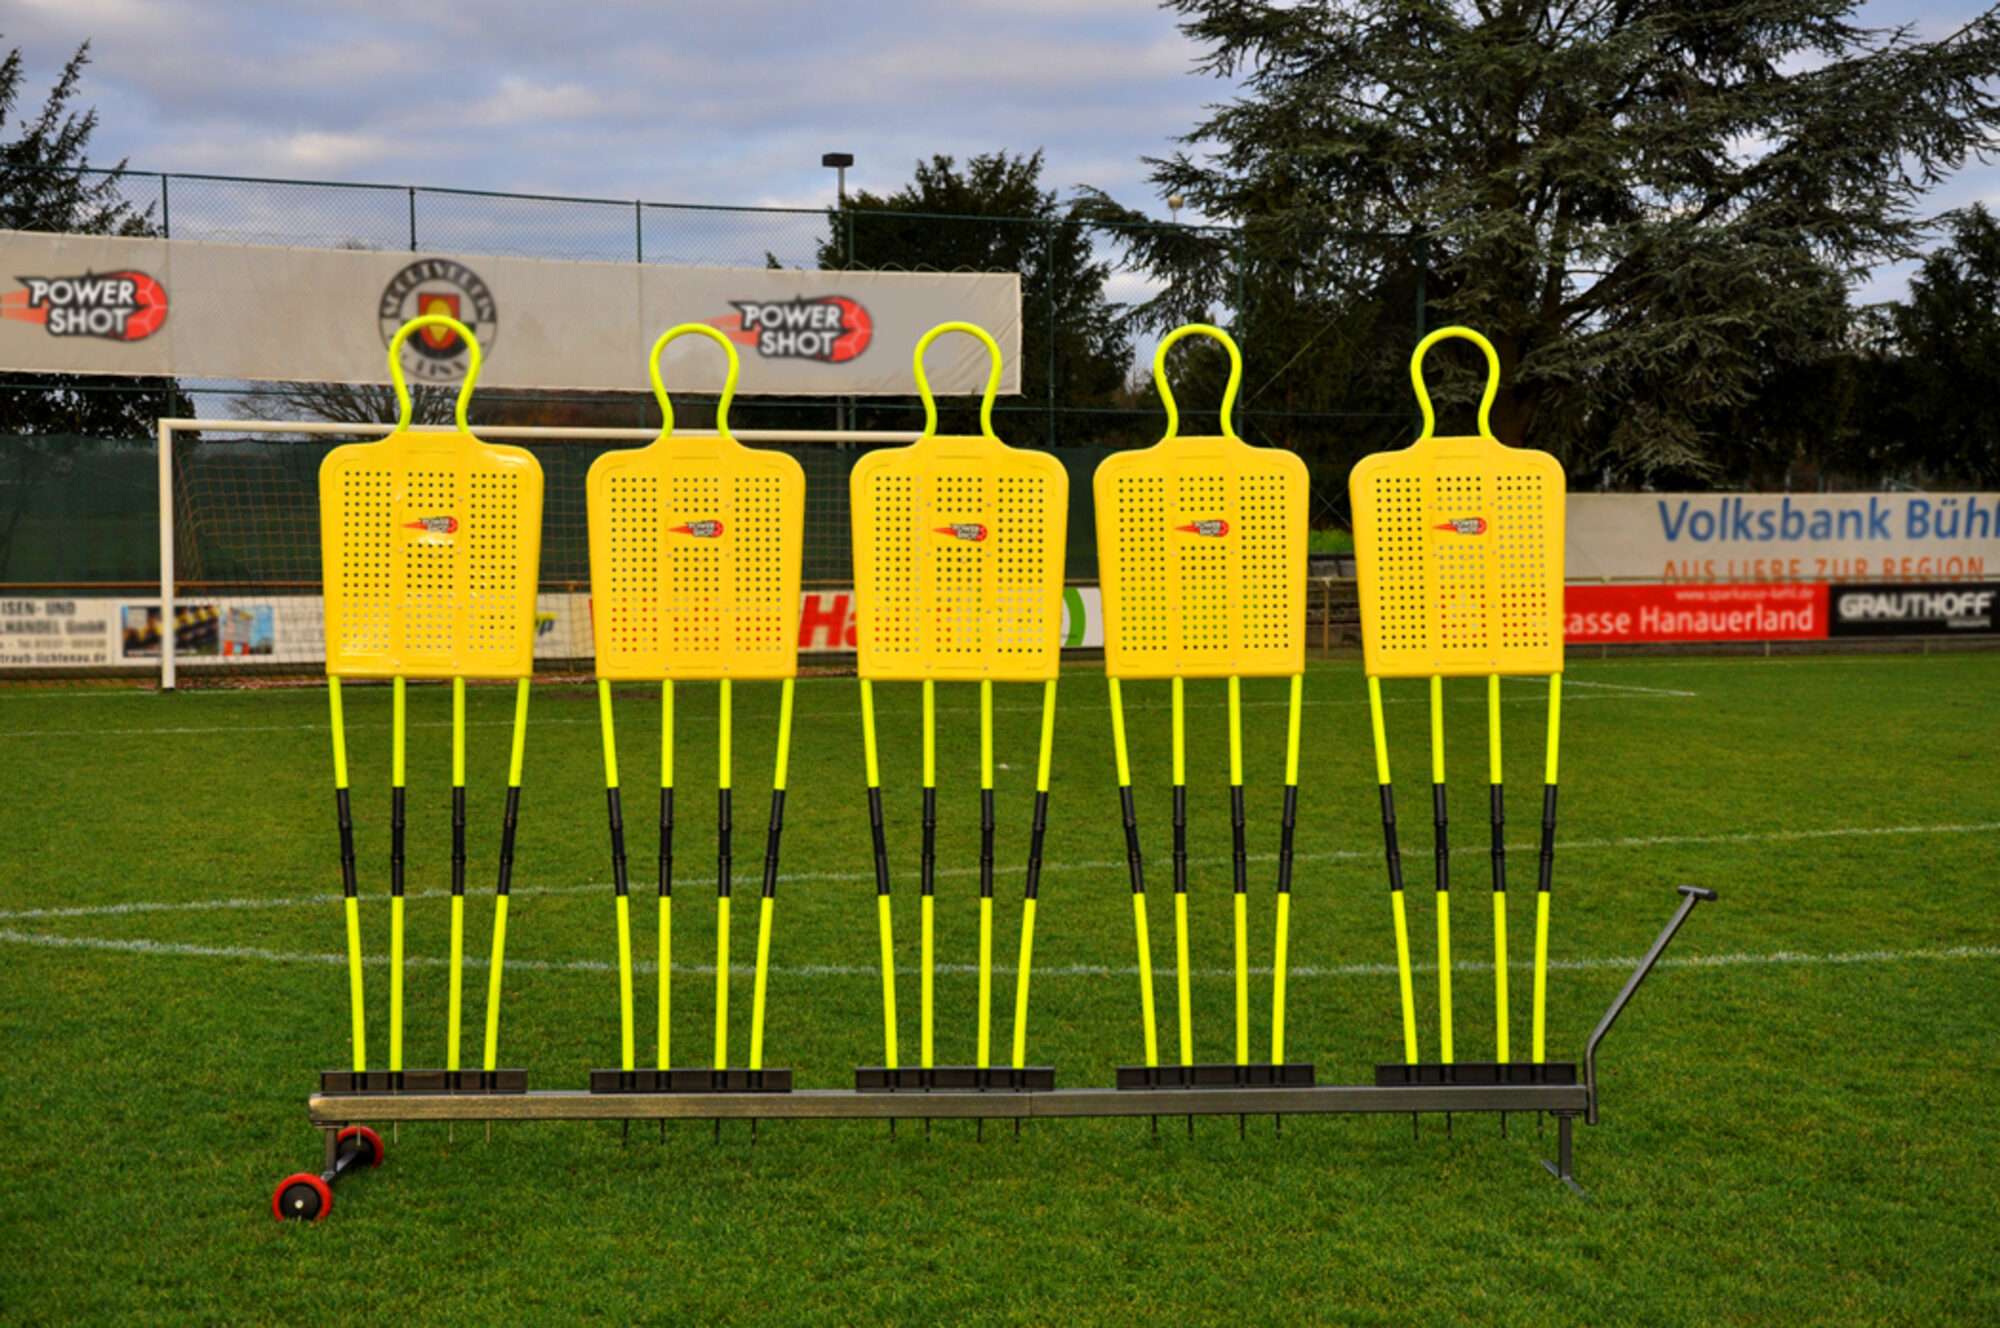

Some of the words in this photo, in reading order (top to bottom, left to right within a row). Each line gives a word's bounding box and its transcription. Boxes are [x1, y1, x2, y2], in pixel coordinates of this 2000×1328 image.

[28, 280, 134, 305] POWER
[50, 307, 132, 334] SHOT
[740, 303, 841, 329] POWER
[761, 331, 840, 356] SHOT
[1657, 497, 1891, 541] Volksbank
[1663, 560, 1716, 583] AUS
[1728, 559, 1802, 583] LIEBE
[1815, 557, 1868, 582] ZUR
[1882, 556, 1985, 582] REGION
[1640, 604, 1814, 633] Hanauerland
[1838, 591, 1992, 619] GRAUTHOFF
